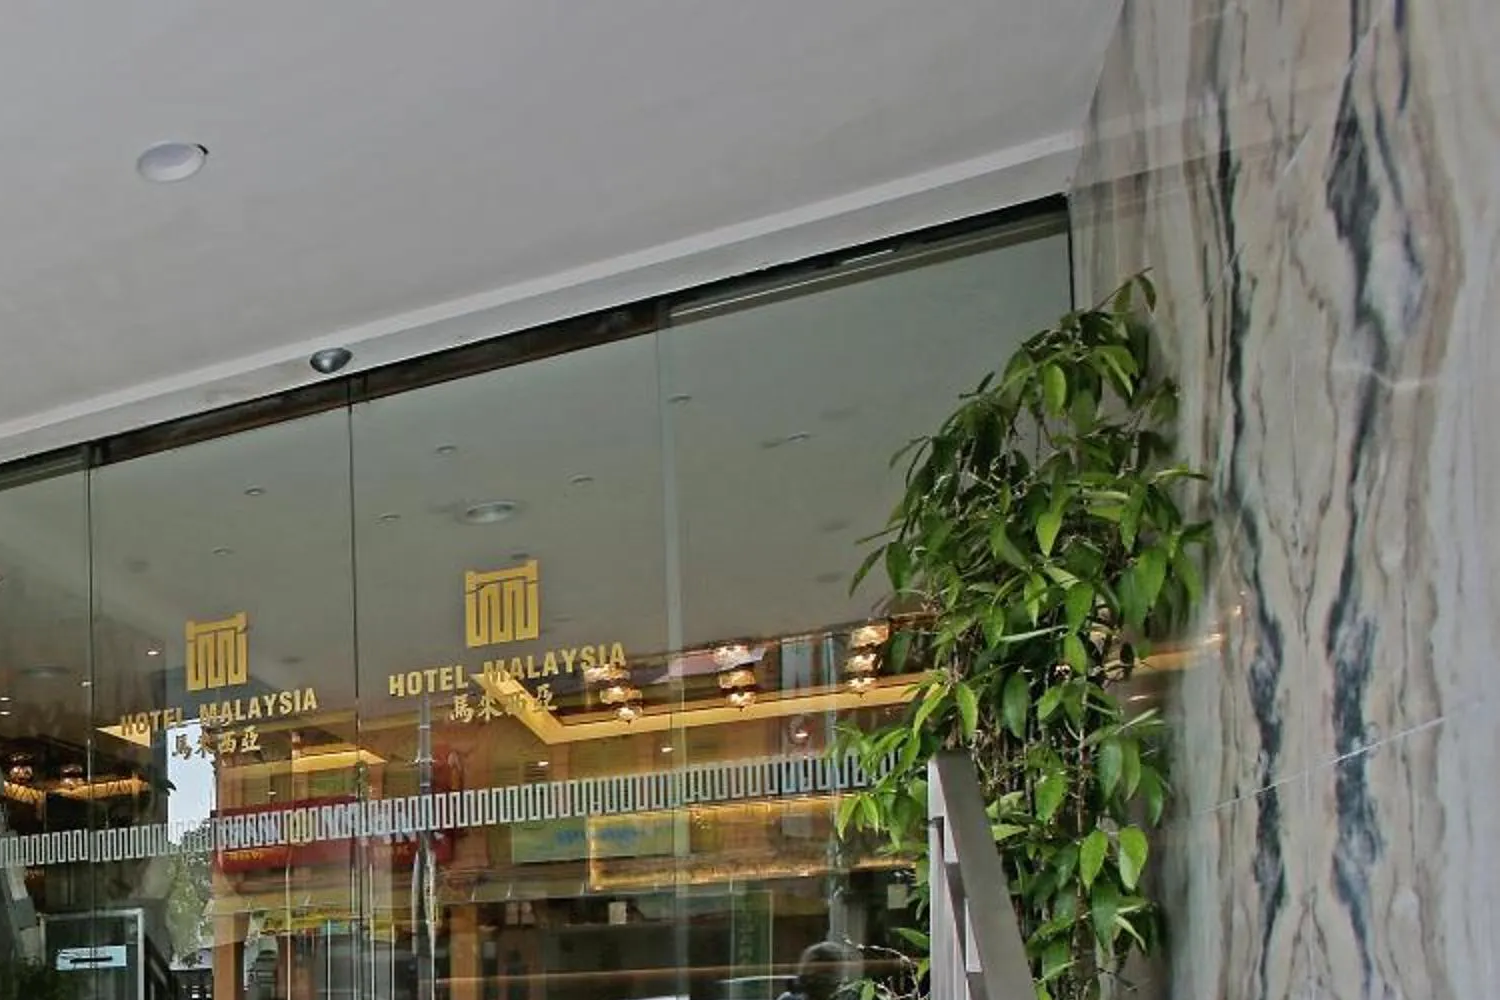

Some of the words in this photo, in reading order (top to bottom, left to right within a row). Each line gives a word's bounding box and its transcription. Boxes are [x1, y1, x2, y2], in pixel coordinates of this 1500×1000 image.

[388, 665, 469, 697] HOTEL
[483, 641, 627, 685] MALAYSIA
[119, 707, 185, 737] HOTEL
[198, 687, 318, 724] MALAYSIA
